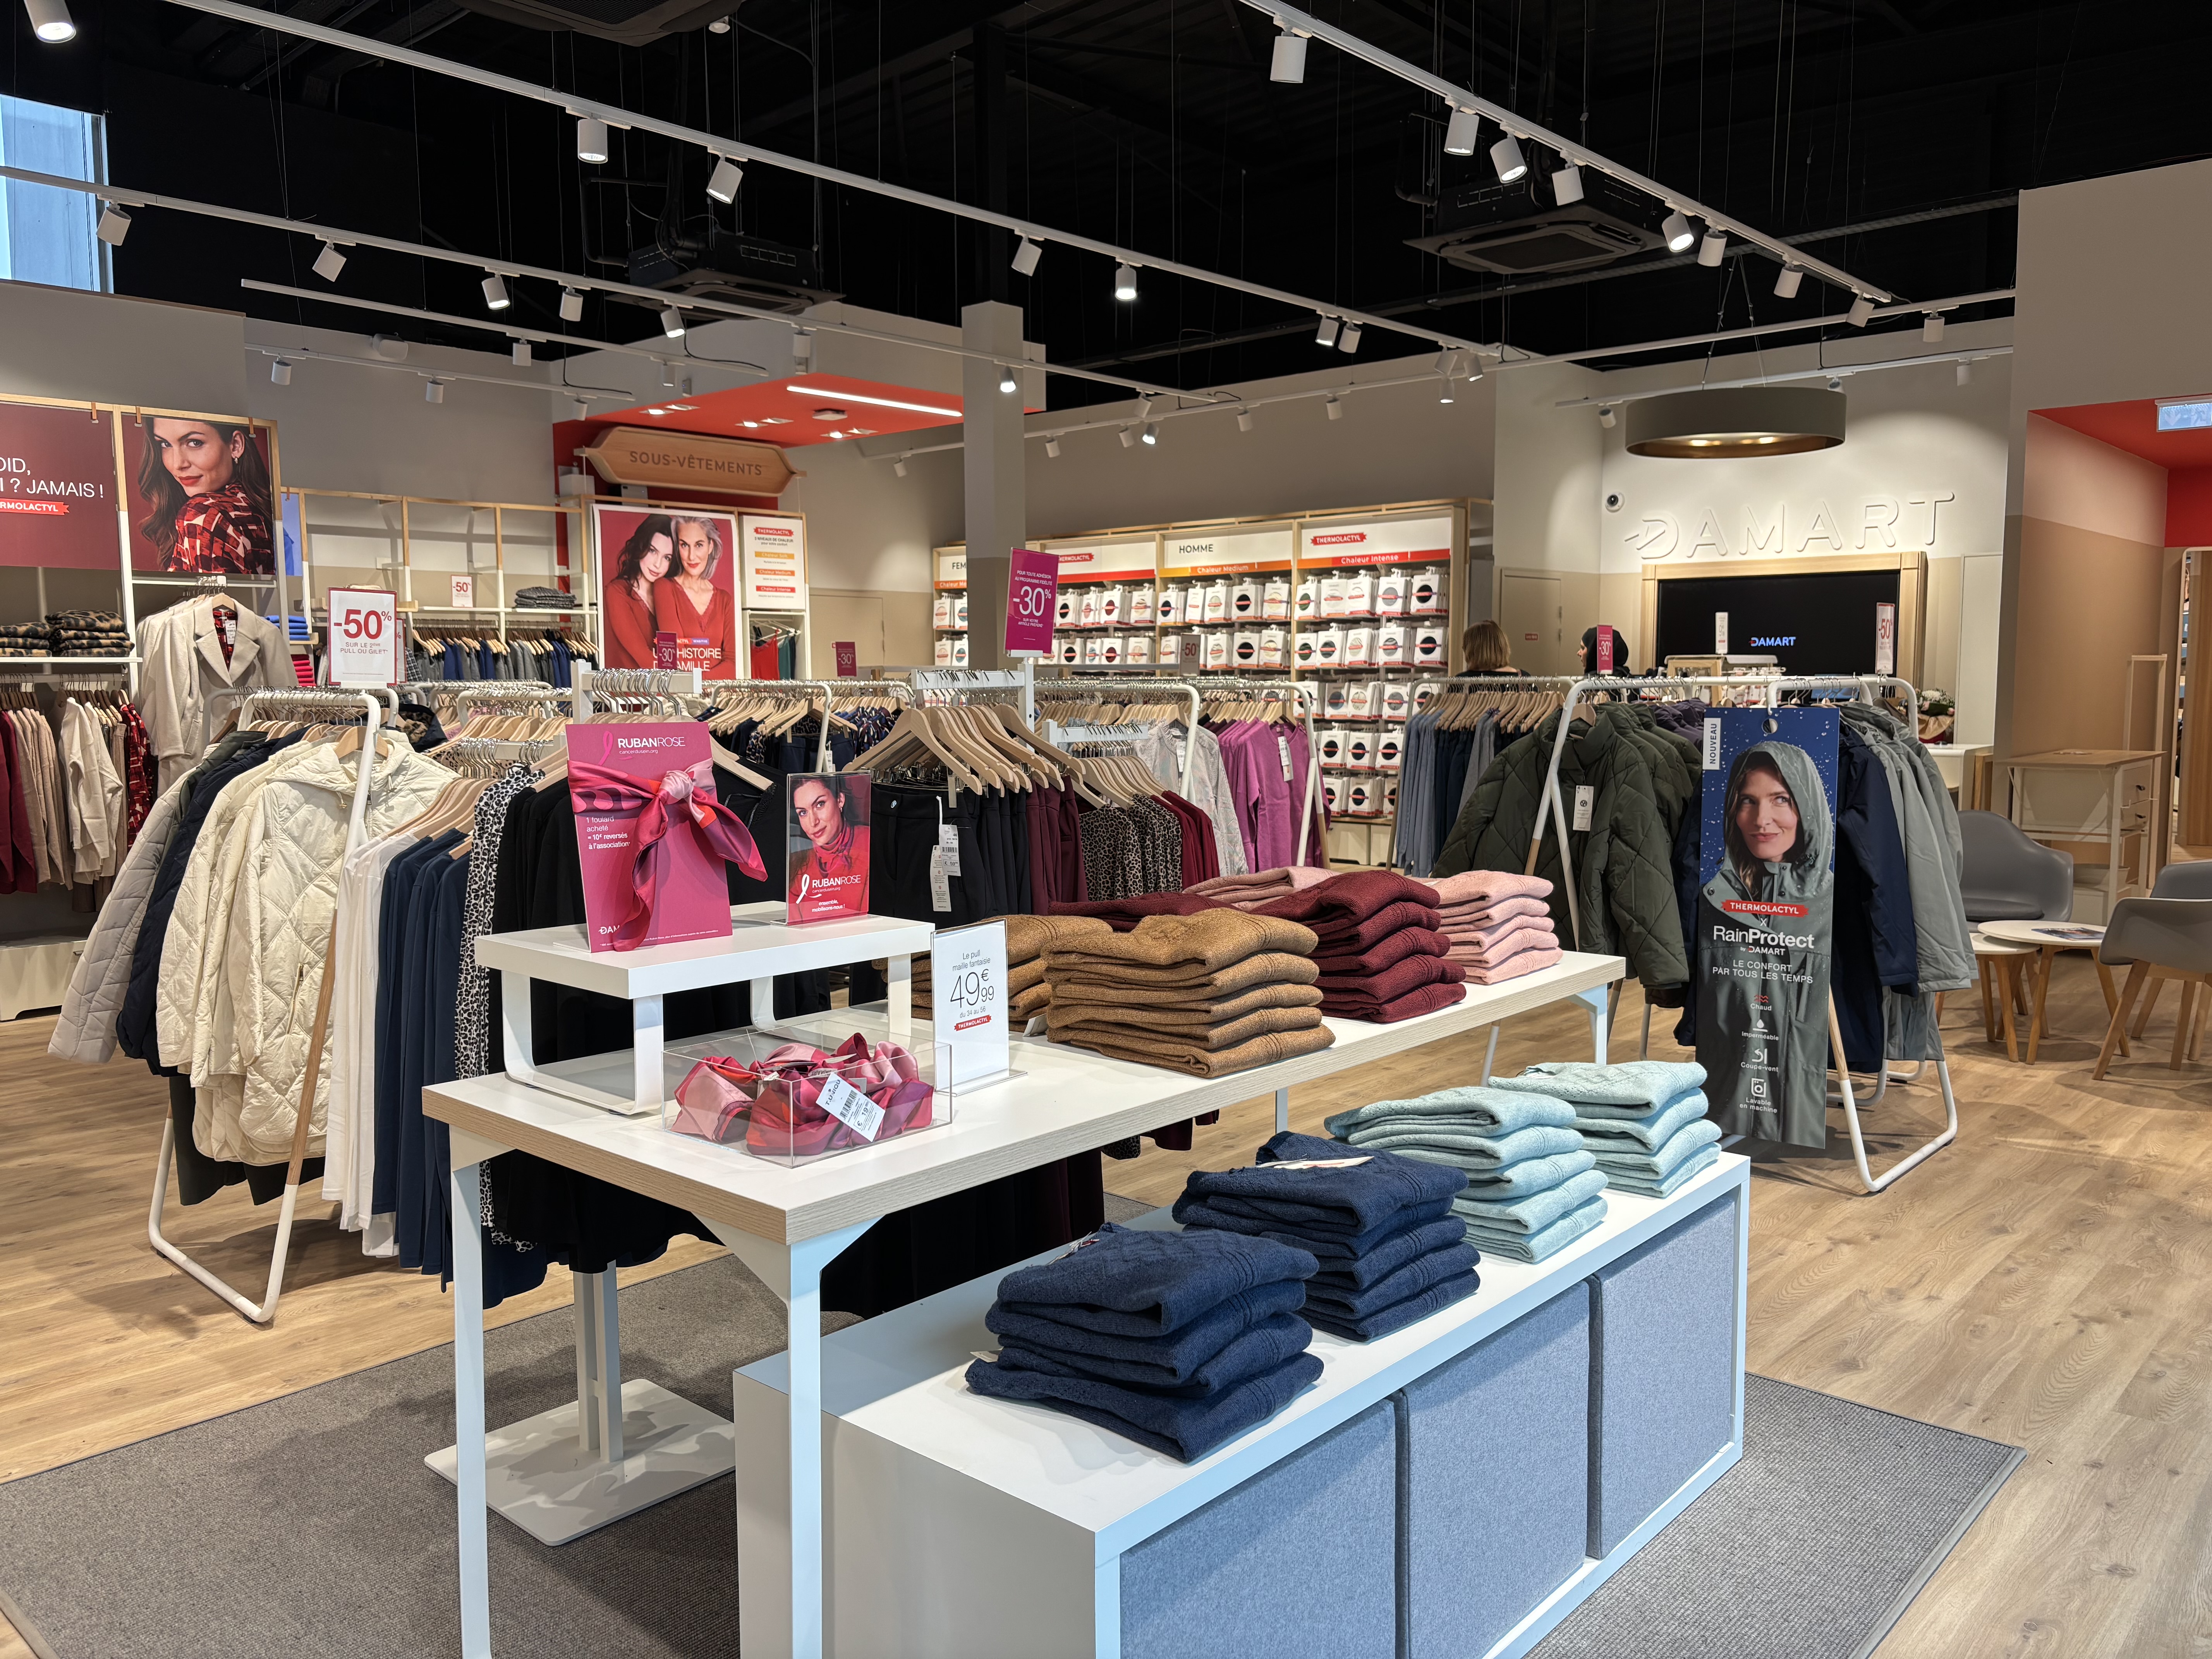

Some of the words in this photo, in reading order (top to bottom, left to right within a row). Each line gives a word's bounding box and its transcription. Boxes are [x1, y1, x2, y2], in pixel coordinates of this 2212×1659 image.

[629, 451, 762, 476] SOUS-VÊTEMENTS
[10, 478, 20, 493] ?
[26, 479, 95, 498] JAMAIS
[100, 484, 104, 498] !
[1625, 491, 1955, 559] DAMART
[1316, 535, 1361, 544] THERMOLACTYL
[1179, 544, 1214, 553] HOMME
[1013, 586, 1051, 616] -30%
[333, 609, 392, 639] -50%
[1749, 637, 1796, 647] DAMART
[677, 648, 721, 659] HISTOIRE
[618, 737, 685, 748] RUBANROSE
[812, 875, 861, 888] RUBANROSE
[1730, 902, 1799, 914] THERMOLACTYL
[1713, 925, 1814, 949] RainProtect
[971, 950, 981, 959] pull
[1748, 946, 1785, 955] DAMART
[953, 962, 968, 971] maille
[970, 957, 991, 967] fantaisie
[1747, 961, 1792, 972] CONFORT
[1712, 967, 1729, 975] PAR
[1732, 969, 1757, 978] TOUS
[1761, 972, 1778, 980] LES
[1781, 973, 1813, 984] TEMPS
[958, 1017, 988, 1029] THERMOLACTYL
[1741, 1031, 1779, 1041] Imperméable
[1741, 1062, 1778, 1072] Coupe-vent
[1746, 1097, 1771, 1106] Lavable
[1750, 1105, 1778, 1113] machine
